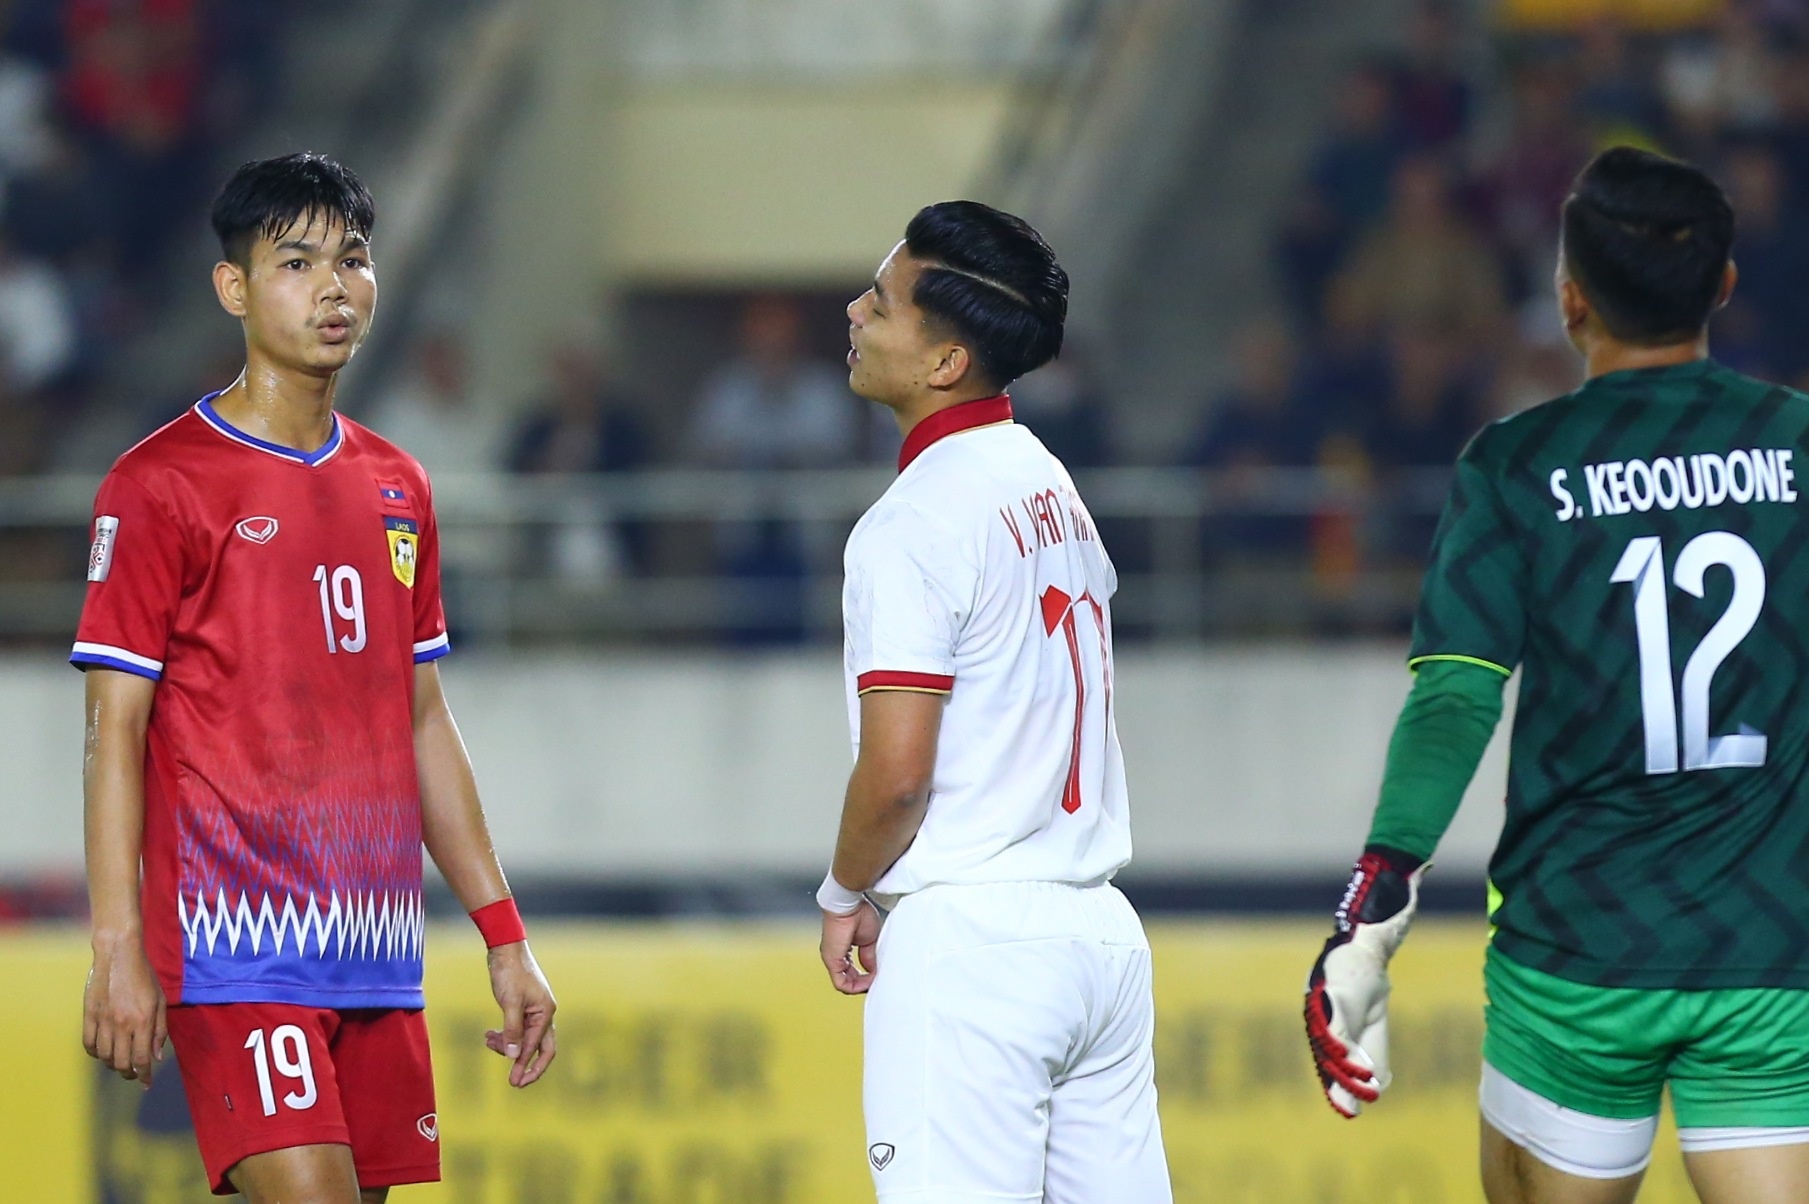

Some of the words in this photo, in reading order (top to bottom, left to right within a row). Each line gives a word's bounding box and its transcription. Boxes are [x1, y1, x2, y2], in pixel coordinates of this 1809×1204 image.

[999, 503, 1033, 558] V.
[1021, 487, 1067, 550] VAN
[1550, 467, 1584, 522] S.
[1583, 448, 1798, 517] KEOOUDONE
[395, 521, 410, 533] LAOS
[312, 564, 367, 654] 19
[1609, 531, 1767, 775] 12
[243, 1024, 318, 1117] 19
